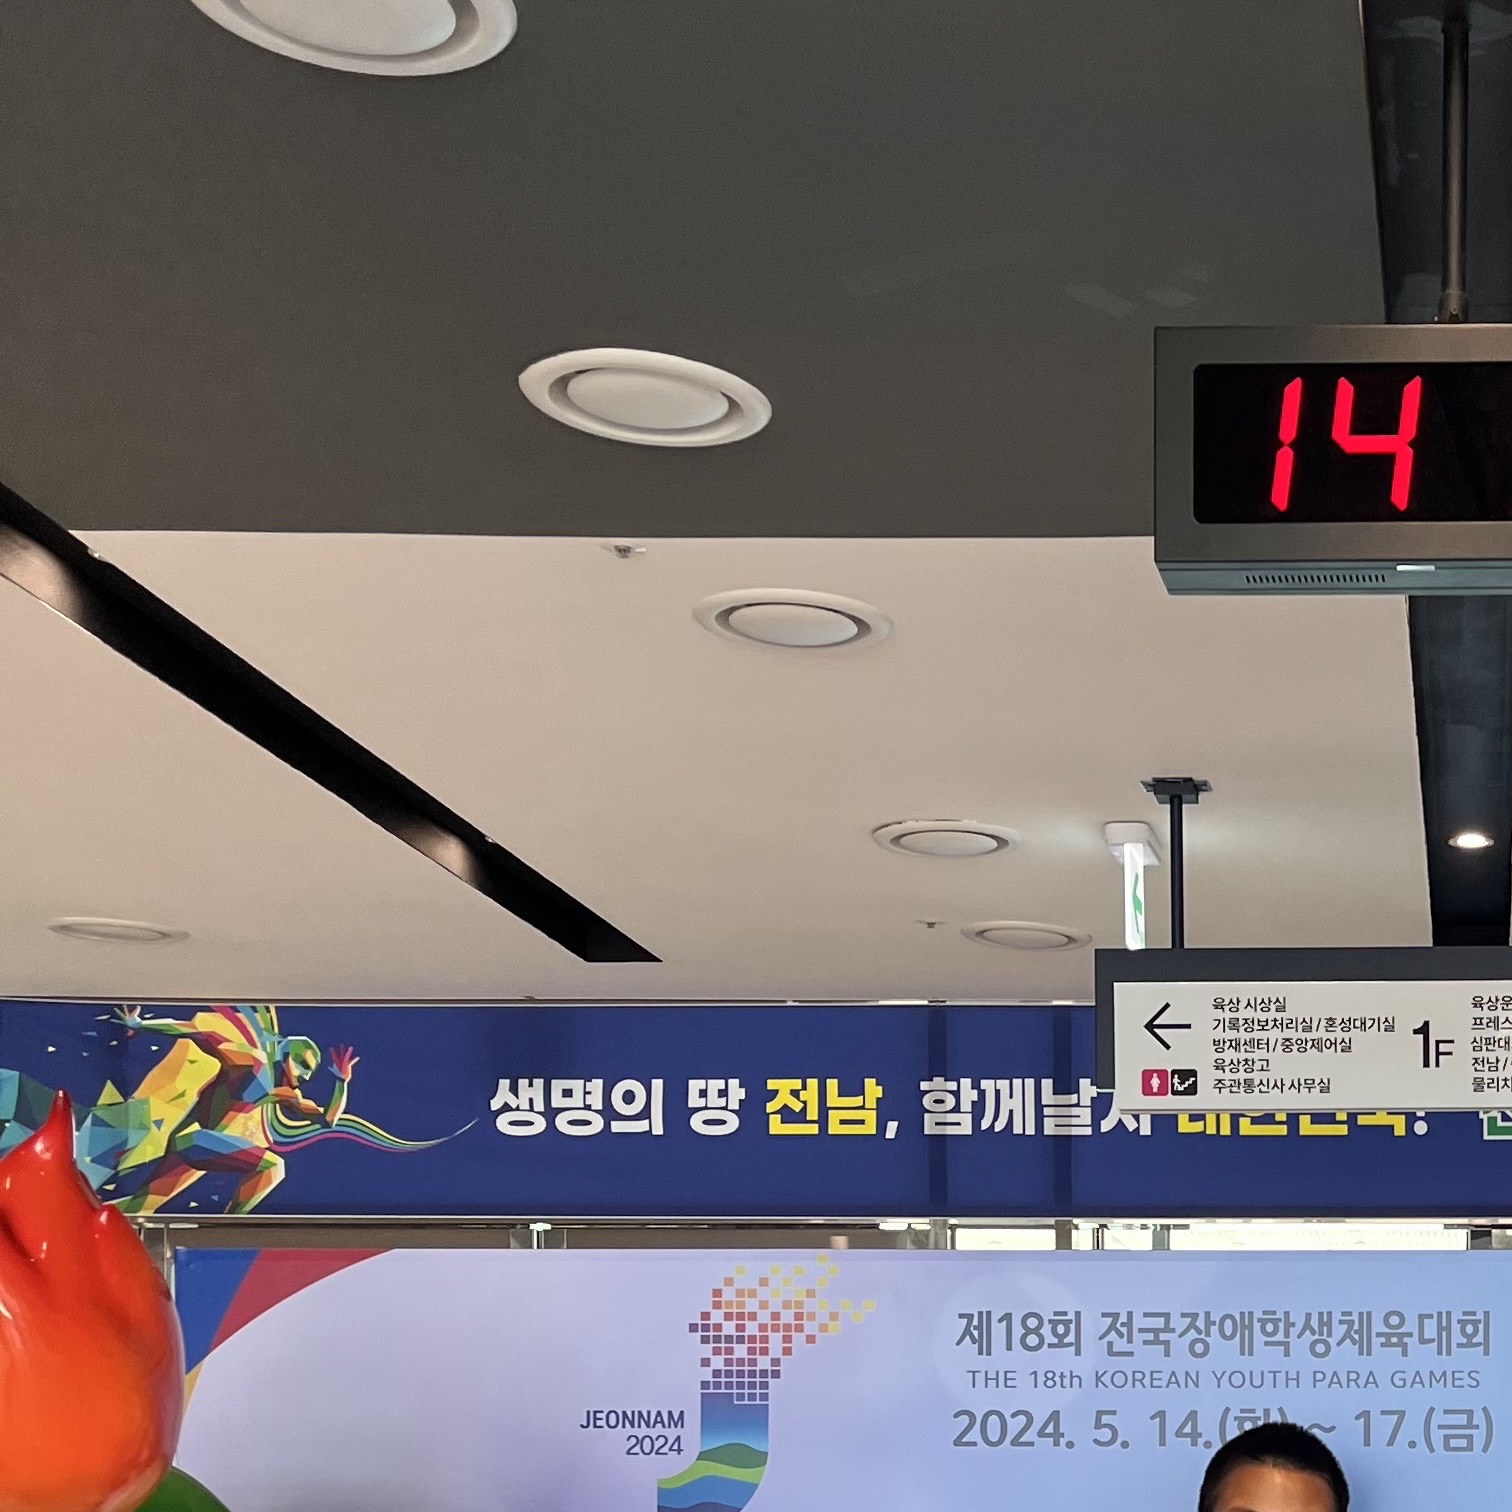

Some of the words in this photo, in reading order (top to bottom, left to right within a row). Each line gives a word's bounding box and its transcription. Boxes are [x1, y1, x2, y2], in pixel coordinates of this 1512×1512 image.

[1270, 375, 1422, 512] 14
[1212, 997, 1241, 1013] 육상
[1243, 996, 1287, 1013] 시상실
[1212, 1017, 1313, 1033] 기록정보처리실
[1323, 1016, 1396, 1033] 혼성대기실
[1212, 1037, 1270, 1054] 방재센터
[1280, 1037, 1353, 1054] 중앙제어실
[1412, 1019, 1455, 1069] 1F
[1212, 1057, 1271, 1074] 육상창고
[1212, 1077, 1285, 1094] 주관통신사
[1287, 1077, 1331, 1094] 사무실
[488, 1077, 665, 1138] 생명의
[685, 1077, 746, 1138] 땅
[764, 1077, 900, 1140] 전남,
[954, 1310, 1083, 1357] 제18회
[1098, 1309, 1491, 1360] 전국장애학생체육대회
[966, 1370, 1018, 1389] THE
[1029, 1369, 1083, 1389] 18th
[1095, 1370, 1201, 1389] KOREAN
[1211, 1370, 1301, 1389] YOUTH
[1312, 1370, 1380, 1389] PARA
[1389, 1369, 1481, 1389] GAMES
[579, 1409, 685, 1429] JEONNAM
[952, 1408, 1076, 1450] 2024.
[1092, 1409, 1130, 1450] 5.
[1353, 1405, 1494, 1455] 17.(금)
[625, 1434, 685, 1456] 2024
